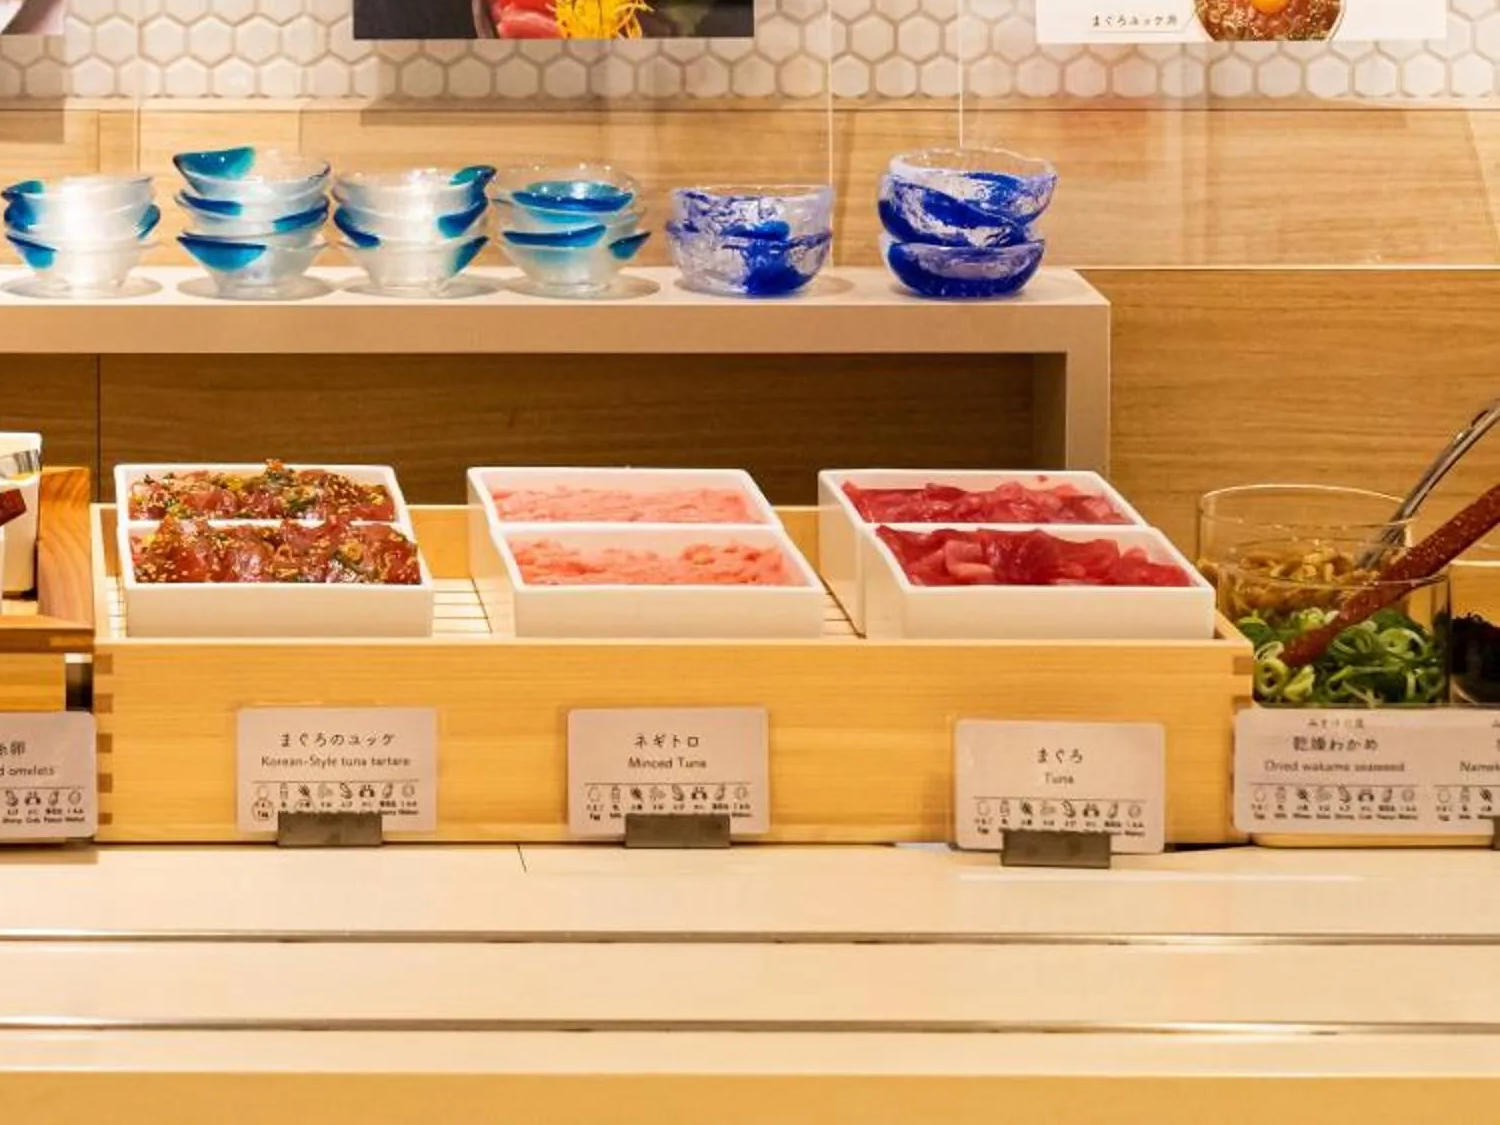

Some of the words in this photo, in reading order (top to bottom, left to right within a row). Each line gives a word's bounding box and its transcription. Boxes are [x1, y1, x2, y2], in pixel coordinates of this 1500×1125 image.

[634, 733, 700, 748] ネギトロ
[627, 756, 673, 769] Minced
[677, 757, 707, 769] Tuna
